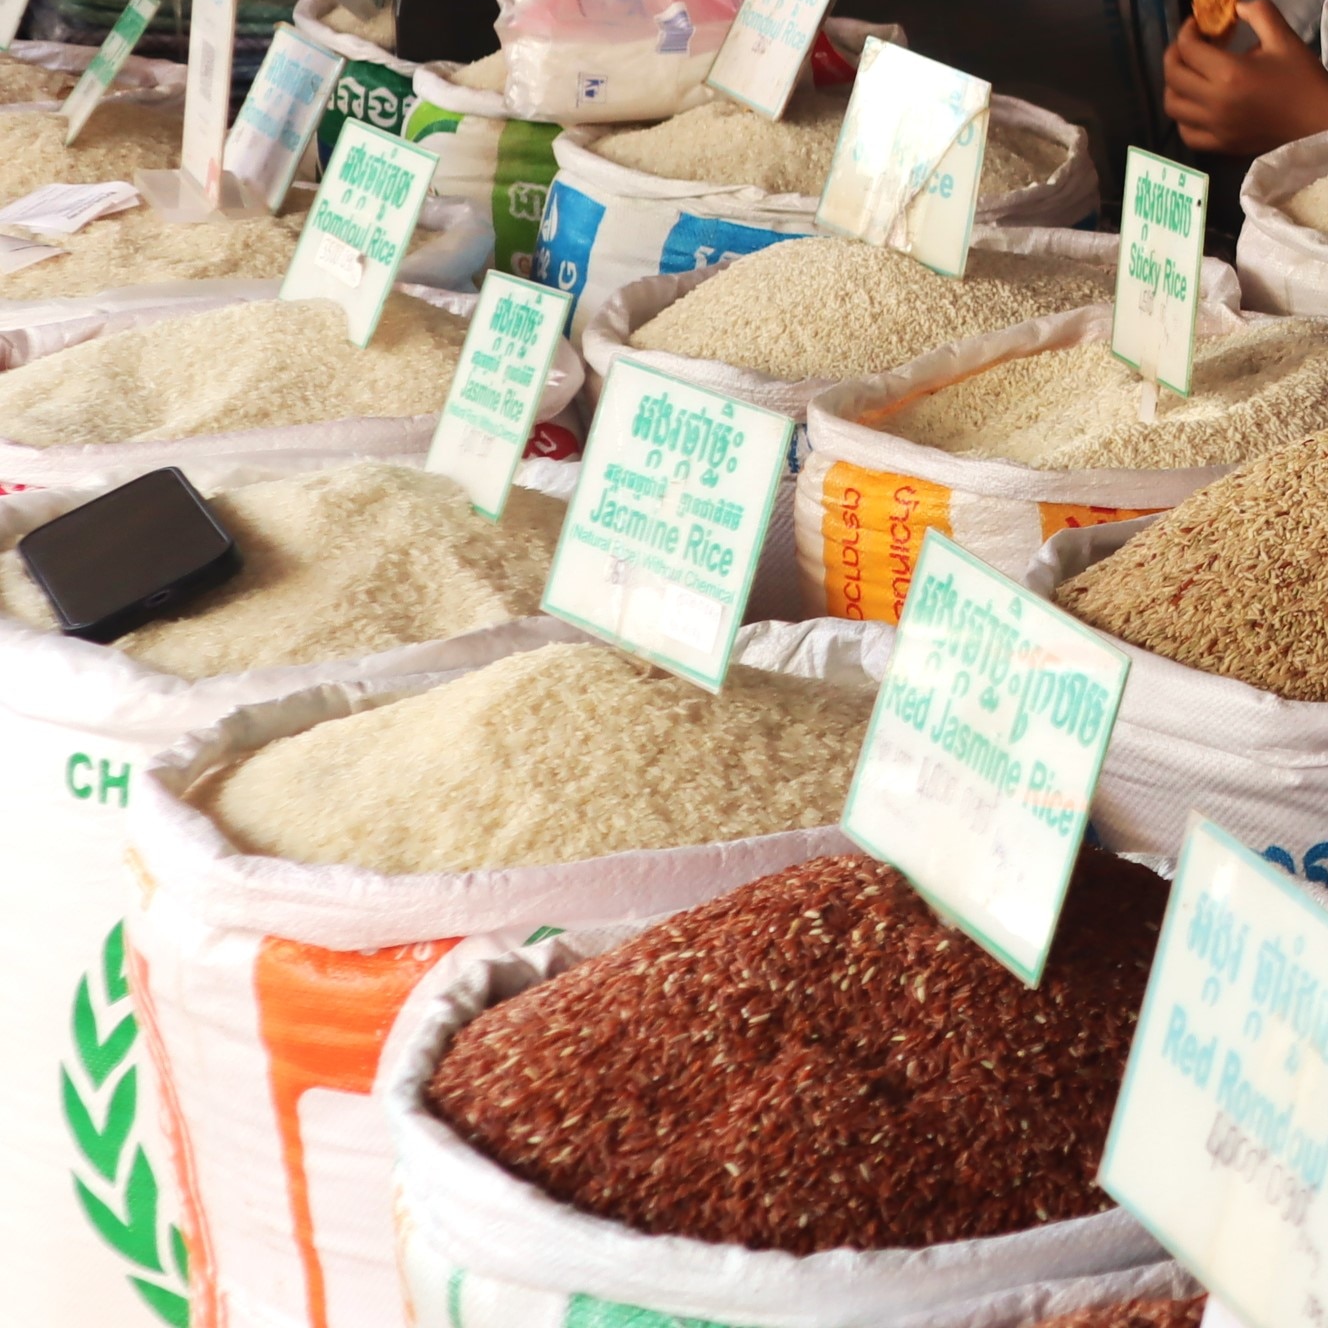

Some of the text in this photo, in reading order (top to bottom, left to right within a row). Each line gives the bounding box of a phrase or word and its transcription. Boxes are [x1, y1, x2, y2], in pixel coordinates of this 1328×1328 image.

[781, 19, 808, 52] Rice
[312, 198, 371, 250] Romdoul
[366, 226, 397, 266] Rice
[1127, 240, 1189, 306] Sticky Rice
[460, 378, 525, 422] Jasmine Rice
[590, 487, 734, 578] Jasmine Rice
[684, 569, 736, 605] Chemical
[885, 673, 934, 732] Red
[929, 697, 1022, 799] Jasmine
[1023, 758, 1076, 837] Rice
[1160, 1001, 1218, 1090] Red
